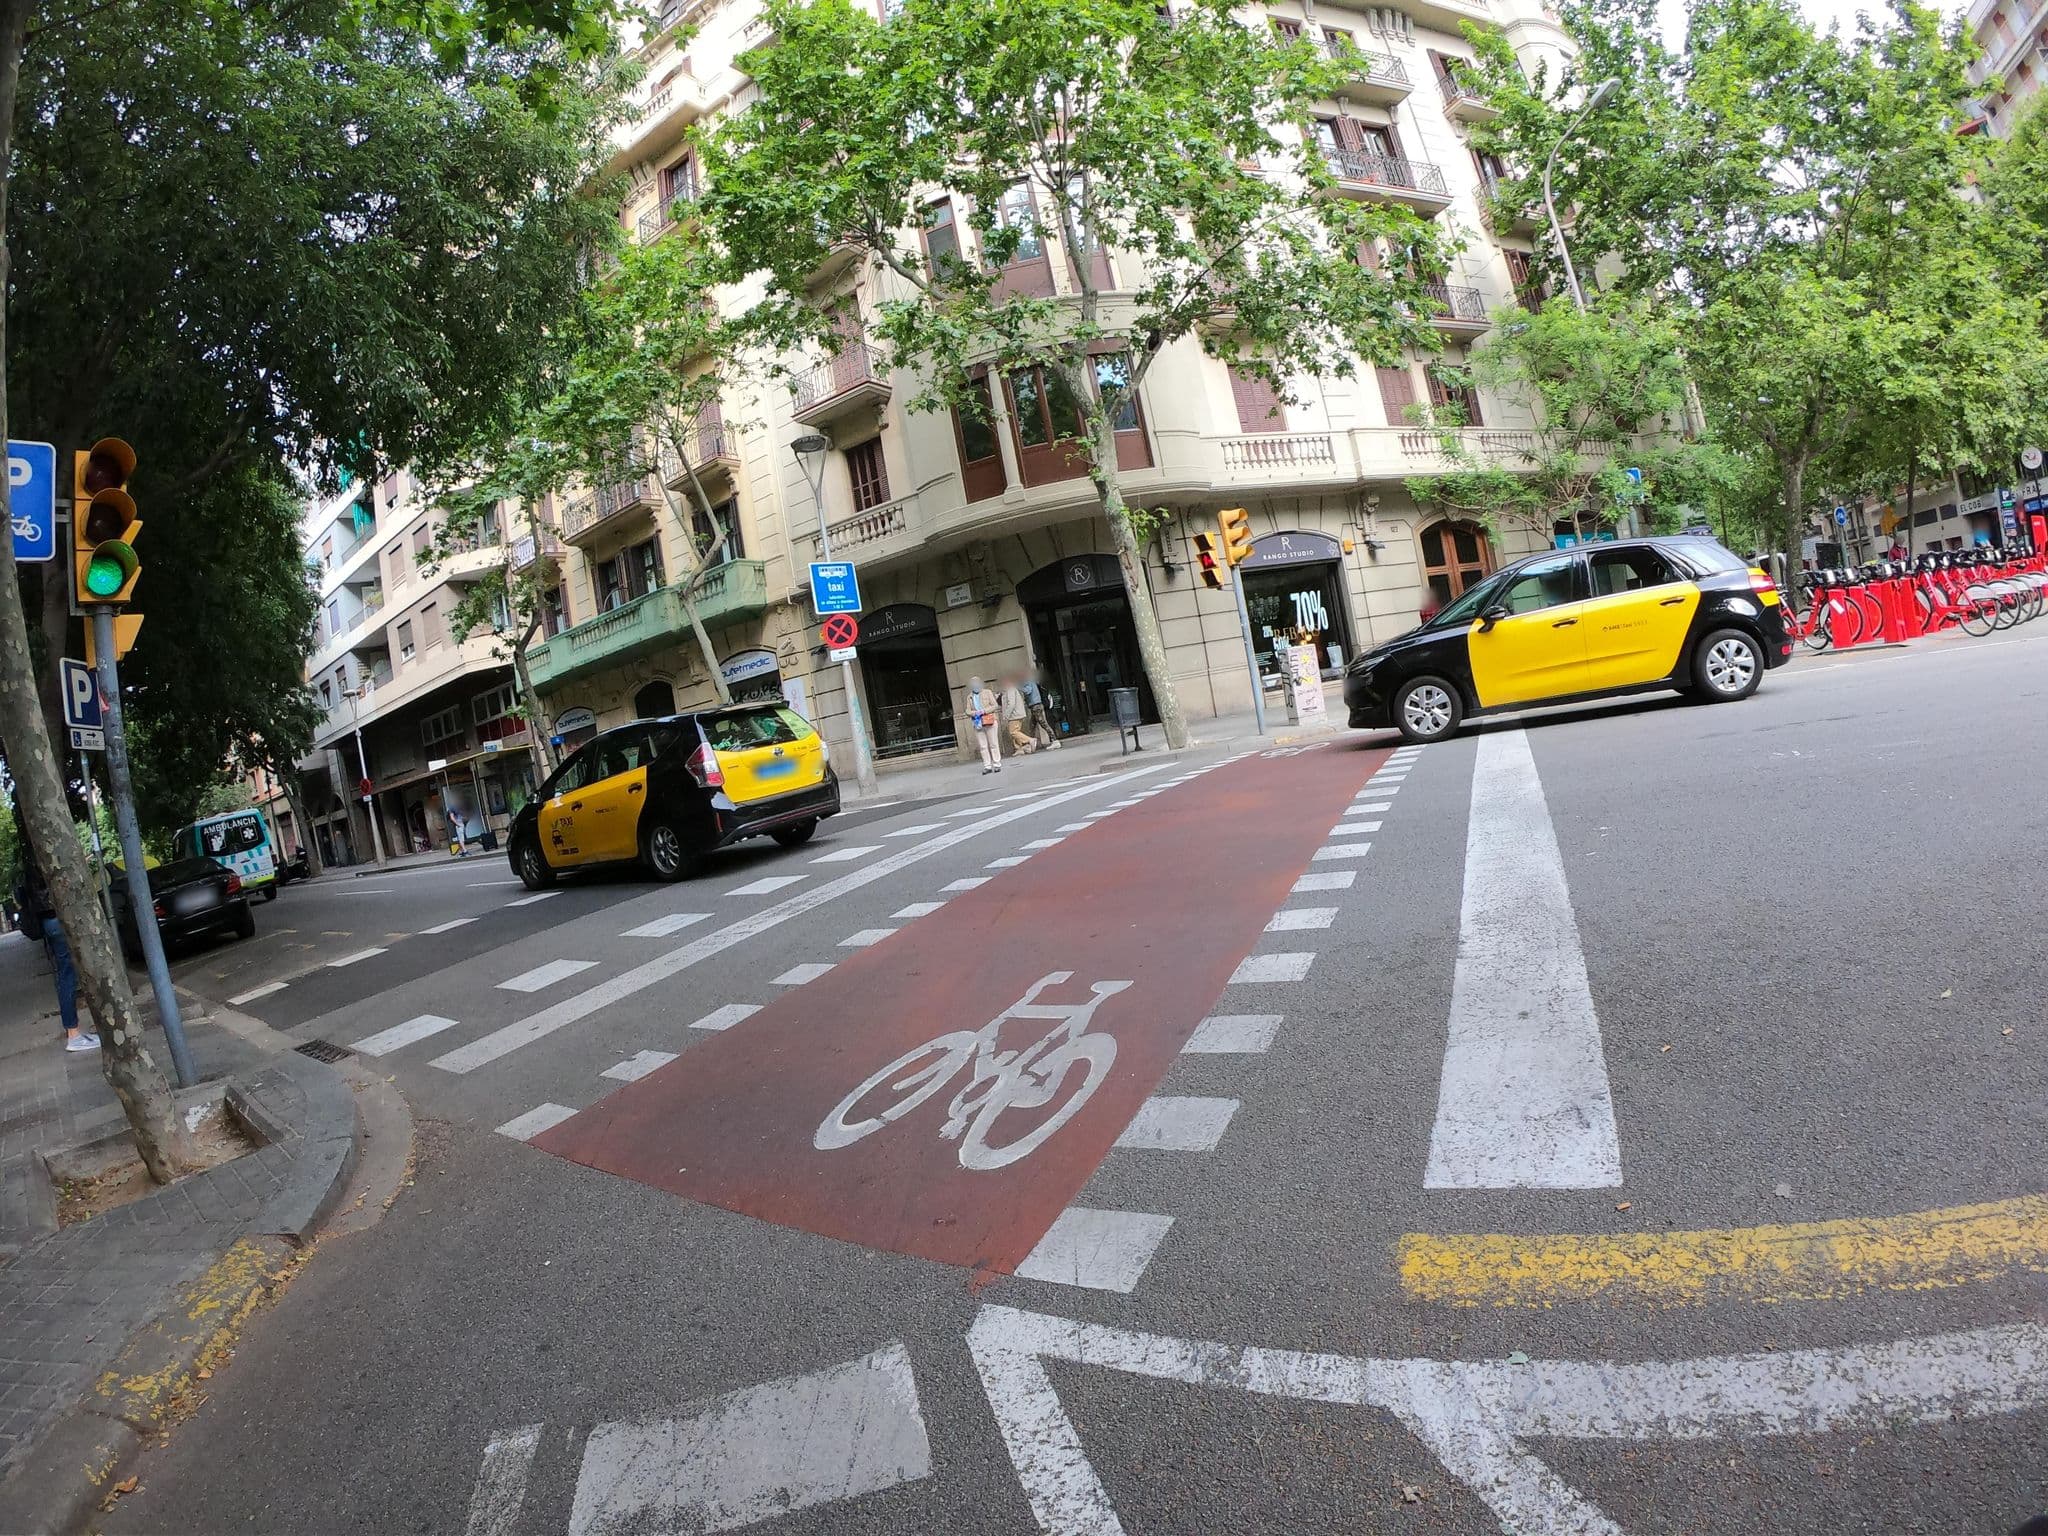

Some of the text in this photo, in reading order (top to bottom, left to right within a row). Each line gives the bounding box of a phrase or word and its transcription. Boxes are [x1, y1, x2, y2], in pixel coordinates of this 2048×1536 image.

[8, 457, 33, 497] P
[1263, 550, 1314, 560] RANGO STUDIO
[827, 582, 845, 592] taxi
[1290, 590, 1329, 633] 70%
[868, 620, 916, 638] RANGO STUDIO
[70, 668, 93, 719] P
